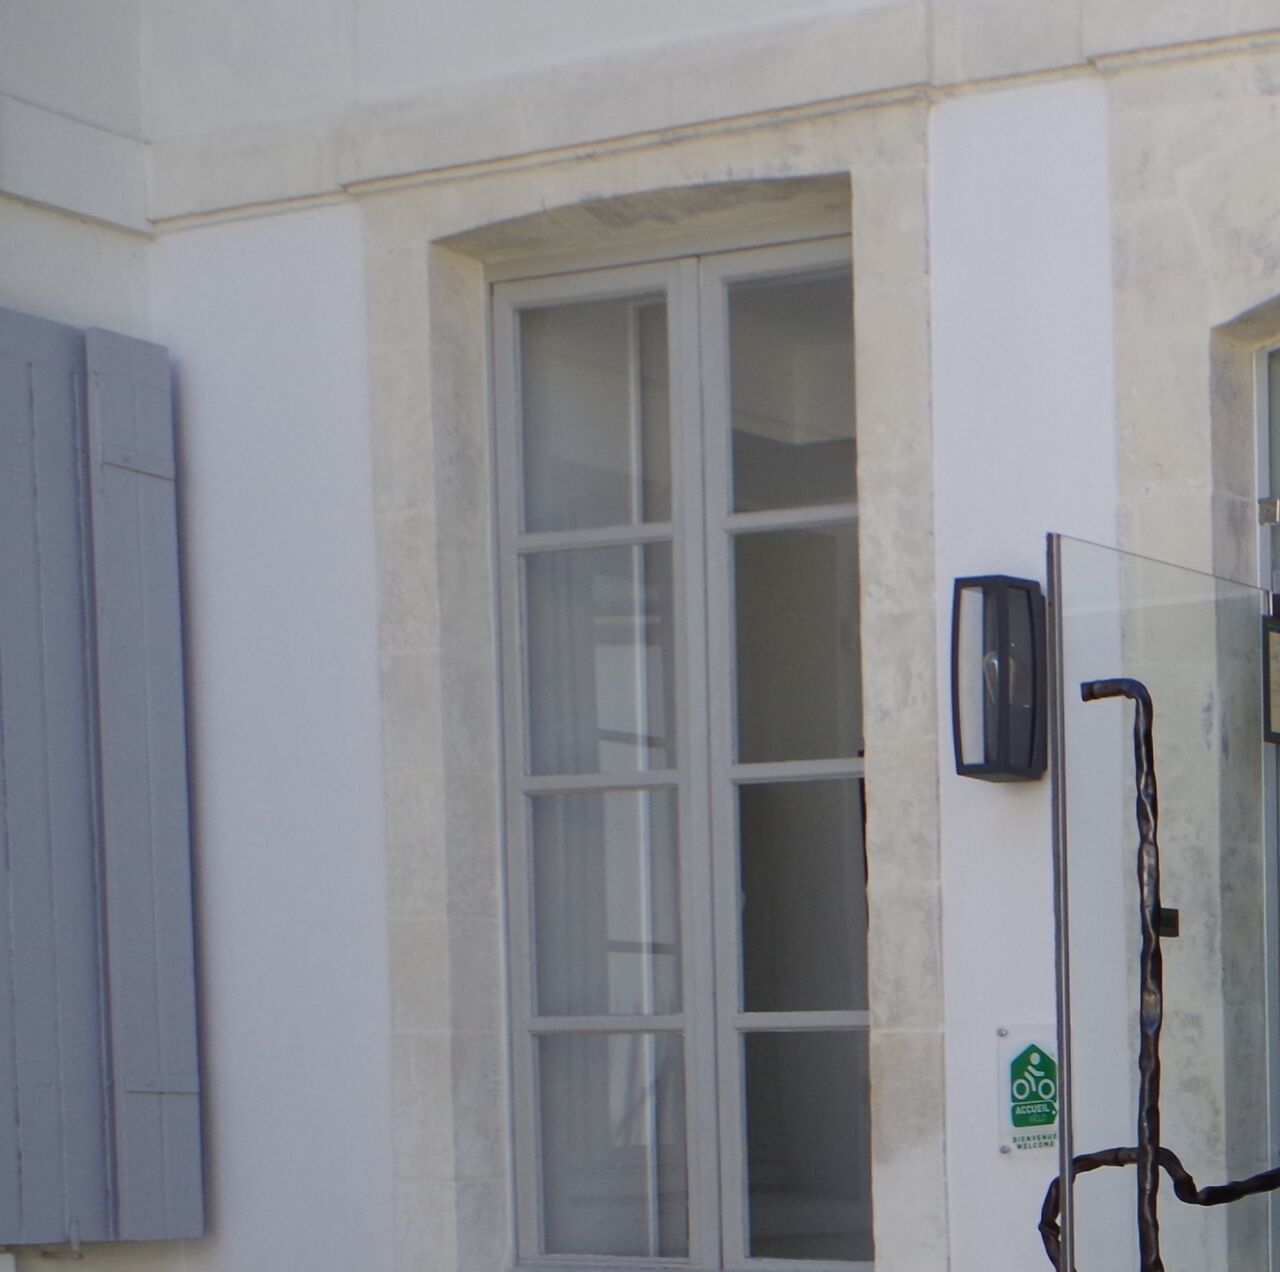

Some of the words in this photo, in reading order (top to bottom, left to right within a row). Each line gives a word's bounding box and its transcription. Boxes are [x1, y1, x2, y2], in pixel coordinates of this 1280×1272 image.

[1016, 1103, 1050, 1114] ACCUEIL
[1012, 1133, 1057, 1143] BIENVENUE
[1017, 1141, 1055, 1150] WELCOME
